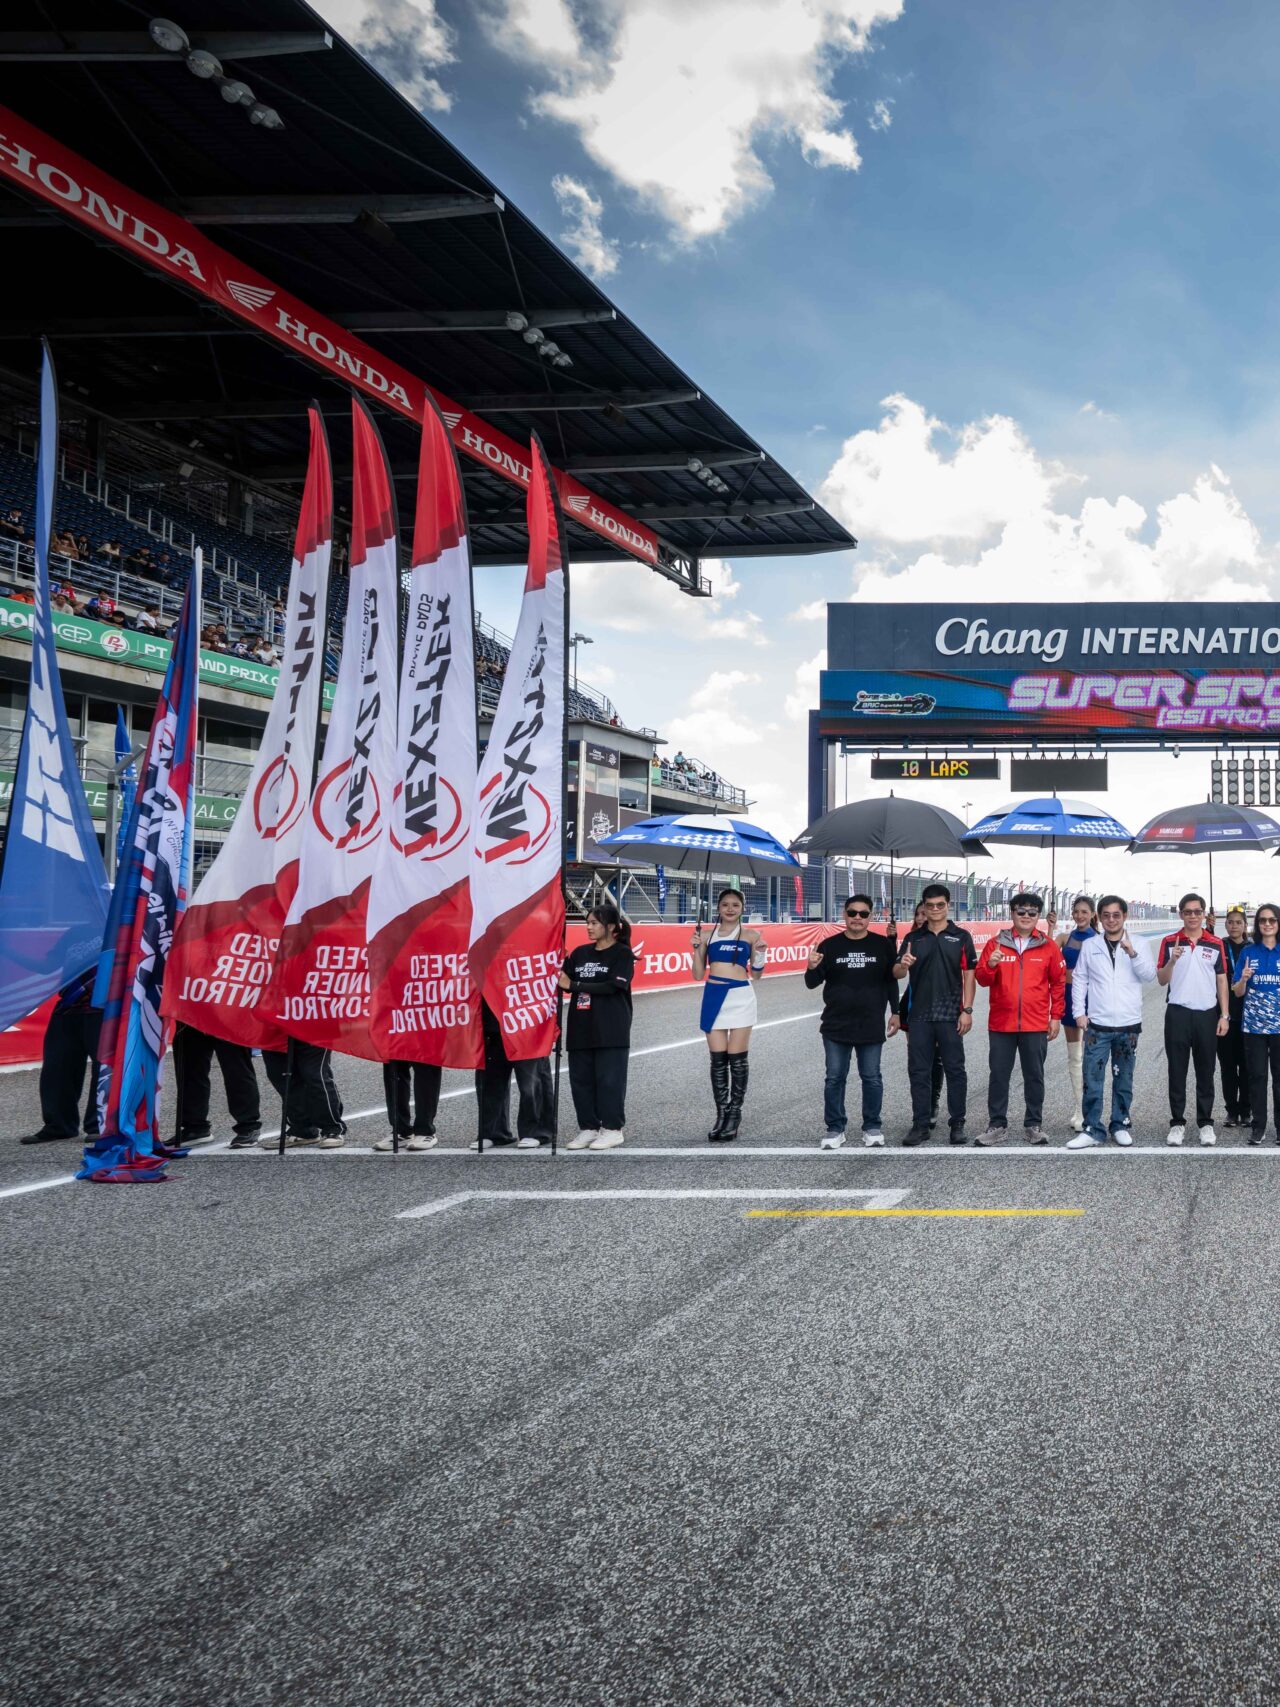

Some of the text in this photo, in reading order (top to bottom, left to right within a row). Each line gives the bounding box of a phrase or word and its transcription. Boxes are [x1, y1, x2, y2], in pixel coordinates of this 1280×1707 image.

[274, 307, 413, 411] HONDA
[462, 426, 532, 483] HON
[589, 504, 656, 558] HONDA
[935, 617, 1068, 662] Chang
[144, 643, 168, 658] PT
[230, 665, 269, 685] PRIX
[1008, 676, 1186, 708] SUPER
[901, 761, 969, 776] 10 LAPS
[644, 953, 694, 975] HON
[764, 945, 815, 965] HOND
